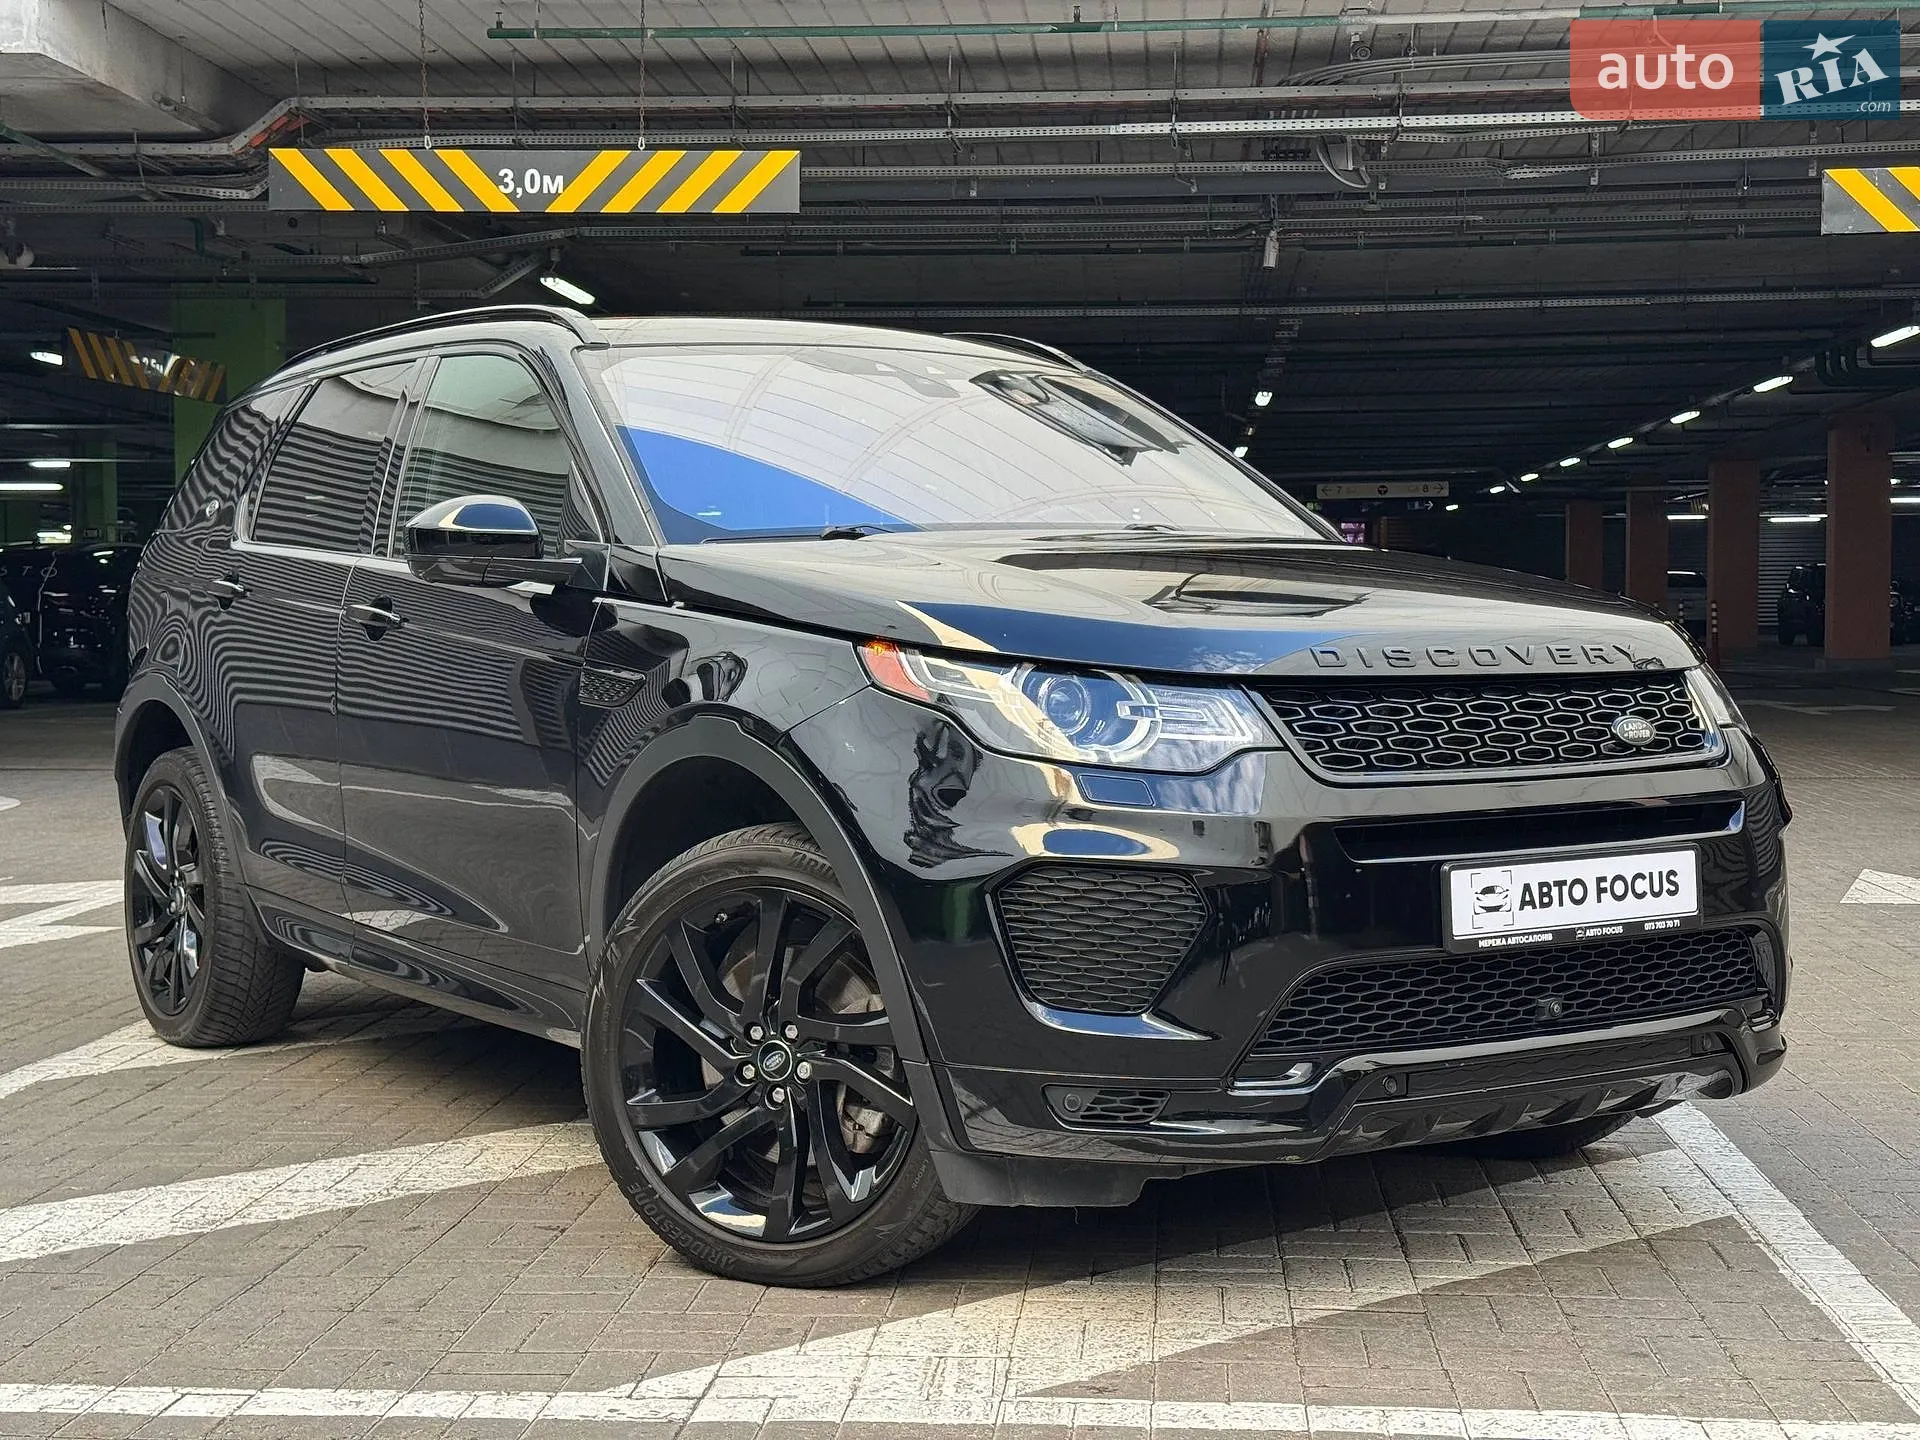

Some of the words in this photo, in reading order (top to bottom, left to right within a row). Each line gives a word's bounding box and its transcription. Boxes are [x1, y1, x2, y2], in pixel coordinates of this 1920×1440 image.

[498, 168, 564, 198] 3,0м
[1310, 644, 1637, 669] DISCOVERY
[1628, 729, 1650, 740] ROVER
[1518, 877, 1588, 912] АВТО
[1596, 869, 1680, 904] FOCUS
[1602, 925, 1624, 936] FOCUS
